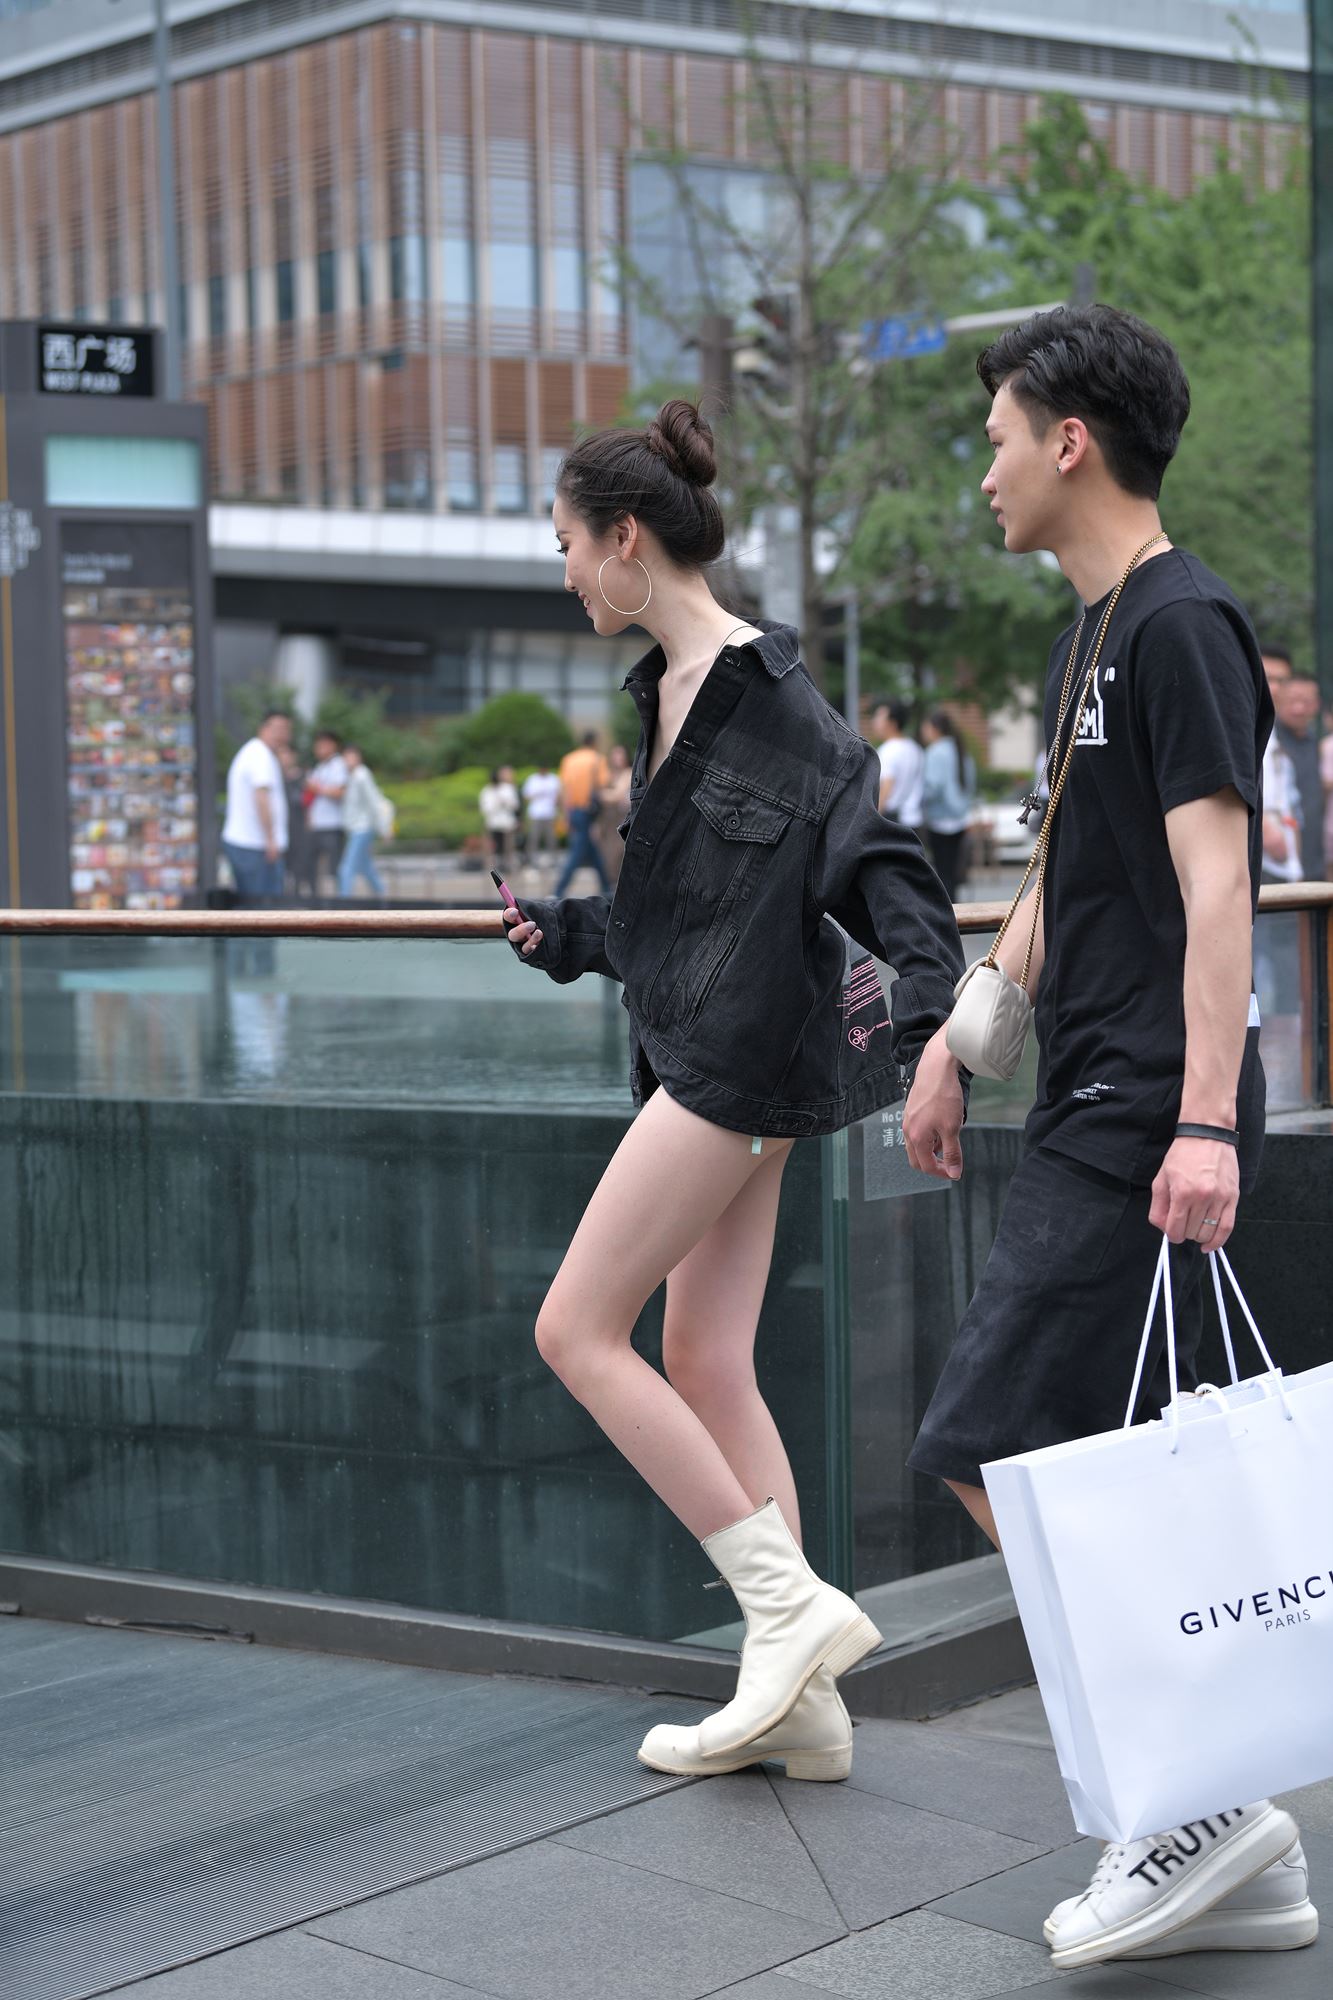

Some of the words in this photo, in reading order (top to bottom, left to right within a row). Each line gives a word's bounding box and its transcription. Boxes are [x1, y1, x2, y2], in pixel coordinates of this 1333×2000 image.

[43, 333, 137, 374] 西广场
[882, 1111, 894, 1123] No
[1264, 1608, 1312, 1632] PARIS
